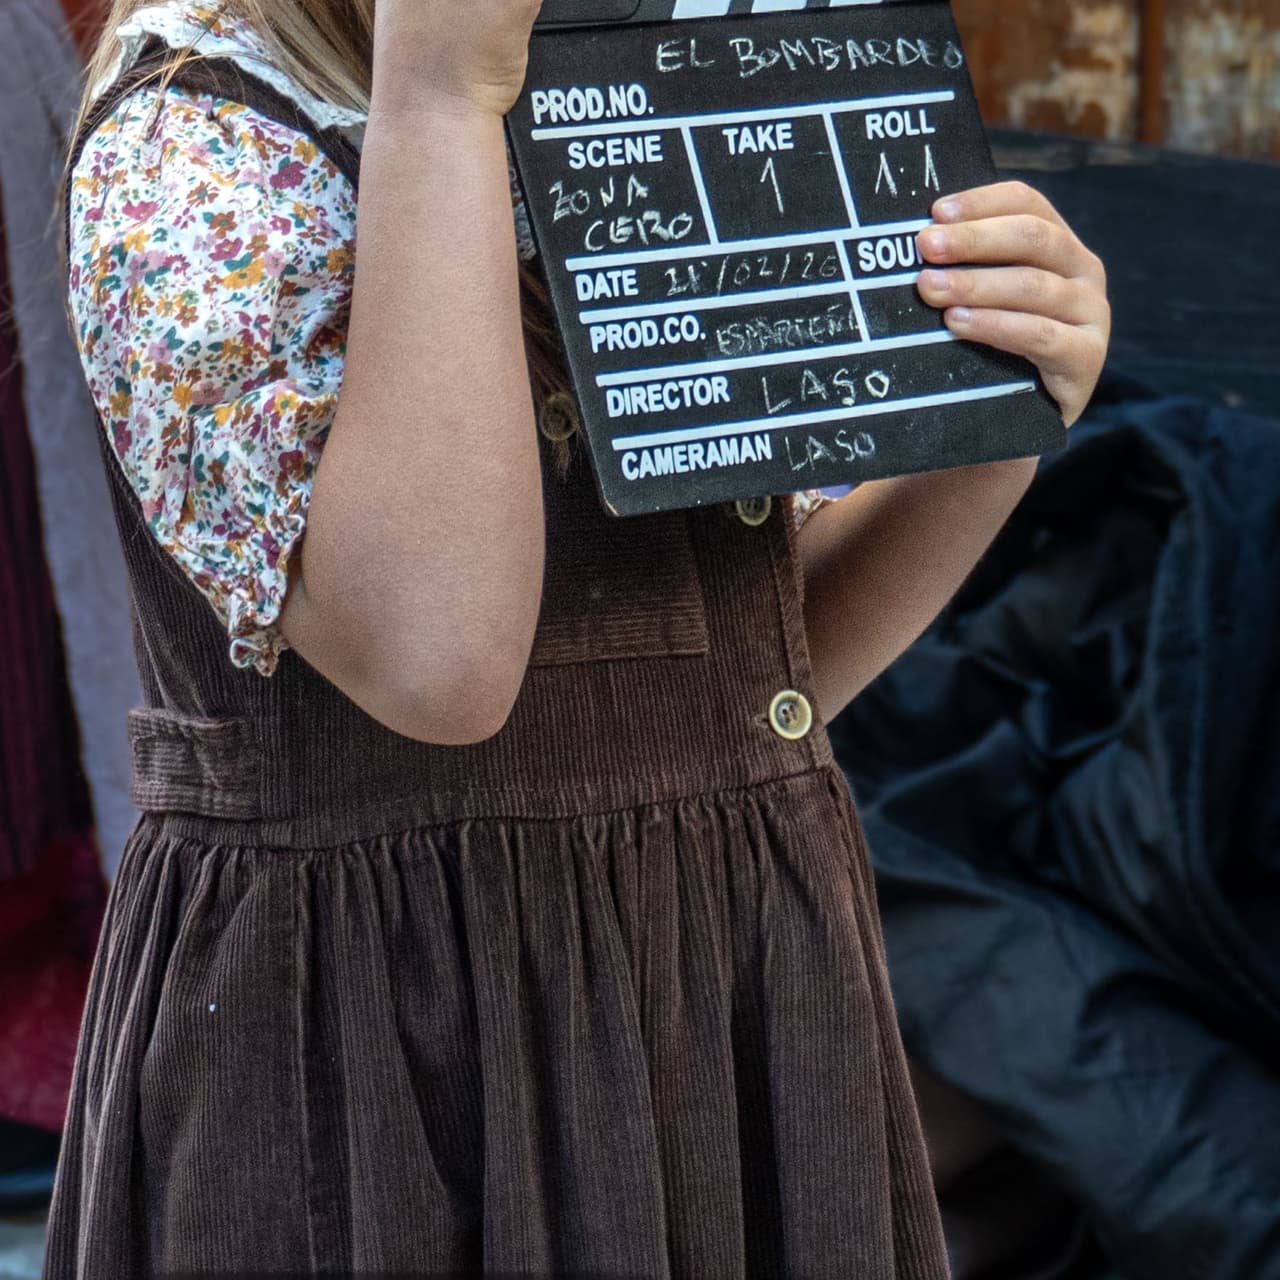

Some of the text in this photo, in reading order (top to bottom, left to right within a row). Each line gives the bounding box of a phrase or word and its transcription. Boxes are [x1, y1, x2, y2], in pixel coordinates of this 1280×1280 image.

[656, 40, 715, 72] EL
[531, 84, 654, 125] PROD.NO.
[865, 109, 936, 141] ROLL
[567, 135, 663, 170] SCENE
[722, 122, 795, 156] TAKE
[548, 173, 649, 224] ZONA
[759, 156, 784, 217] 1
[585, 210, 694, 253] CERO
[857, 235, 923, 272] SOU
[575, 269, 639, 302] DATE
[589, 314, 707, 354] PROD.CO.
[606, 375, 731, 418] DIRECTOR
[762, 367, 890, 415] LASO
[621, 432, 773, 481] CAMERAMAN
[784, 429, 876, 471] LASO
